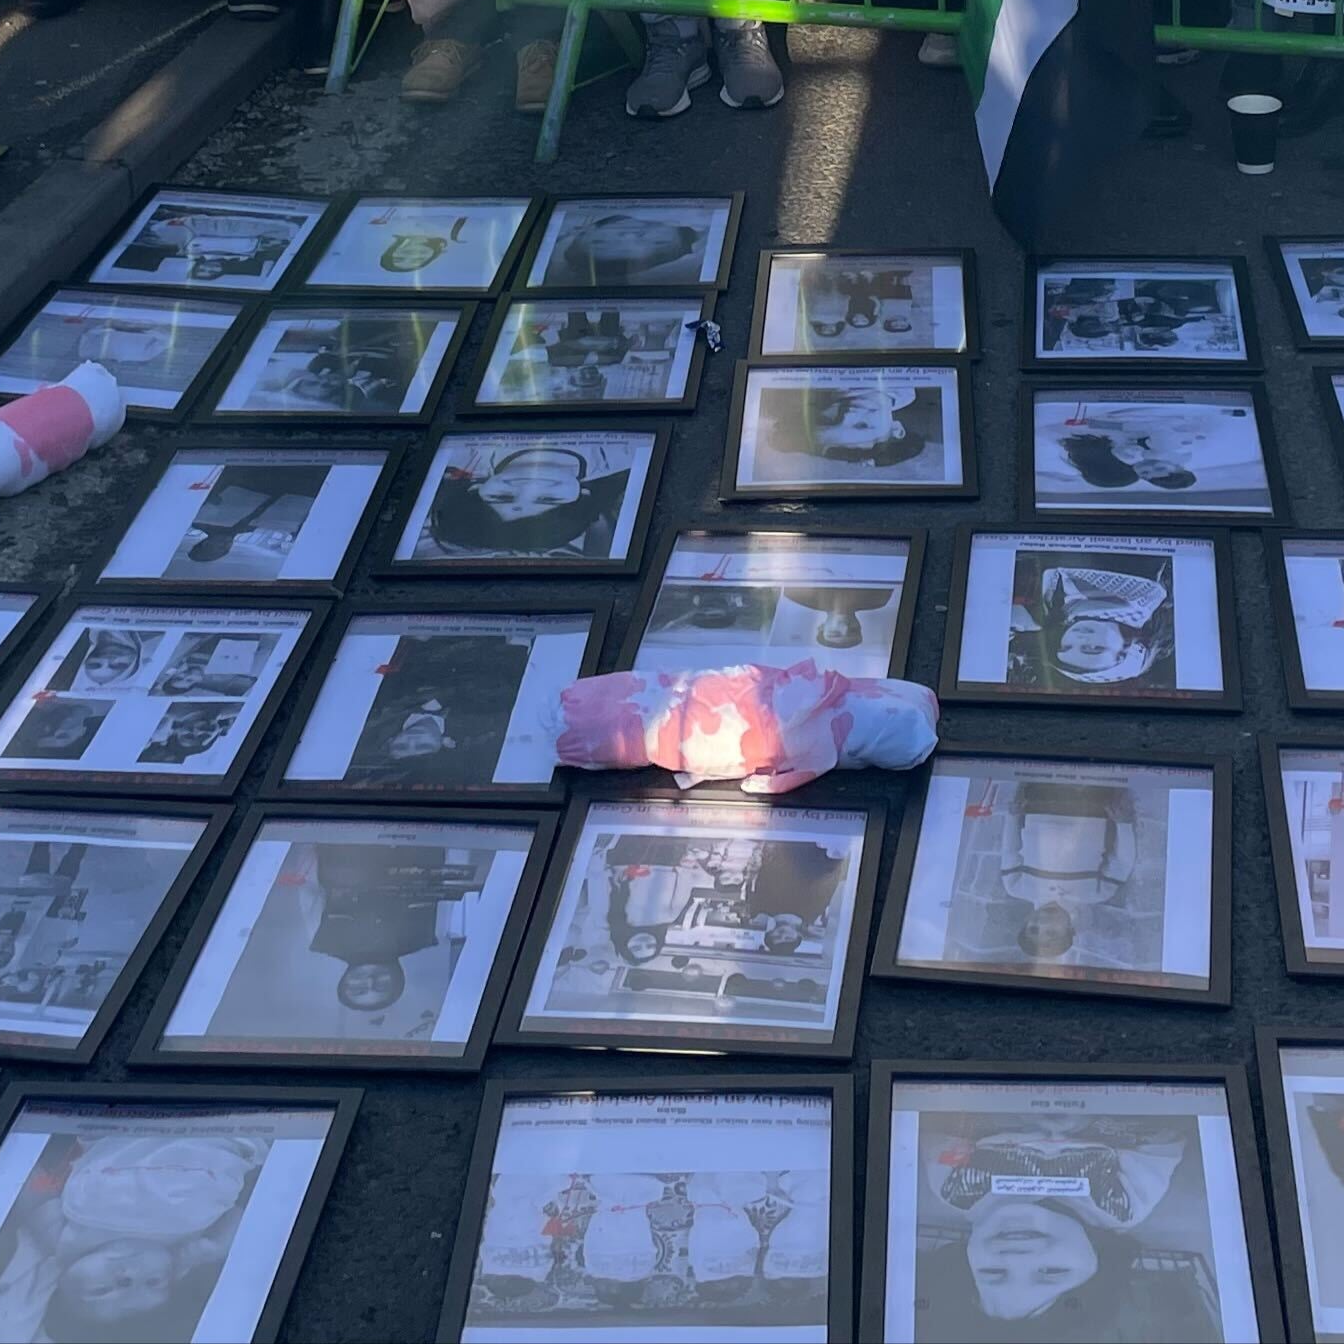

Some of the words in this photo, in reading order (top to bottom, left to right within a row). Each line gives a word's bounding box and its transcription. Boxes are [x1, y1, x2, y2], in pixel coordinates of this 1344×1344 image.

[1089, 536, 1131, 545] Israeli
[1155, 536, 1171, 546] by
[1176, 539, 1213, 548] killed
